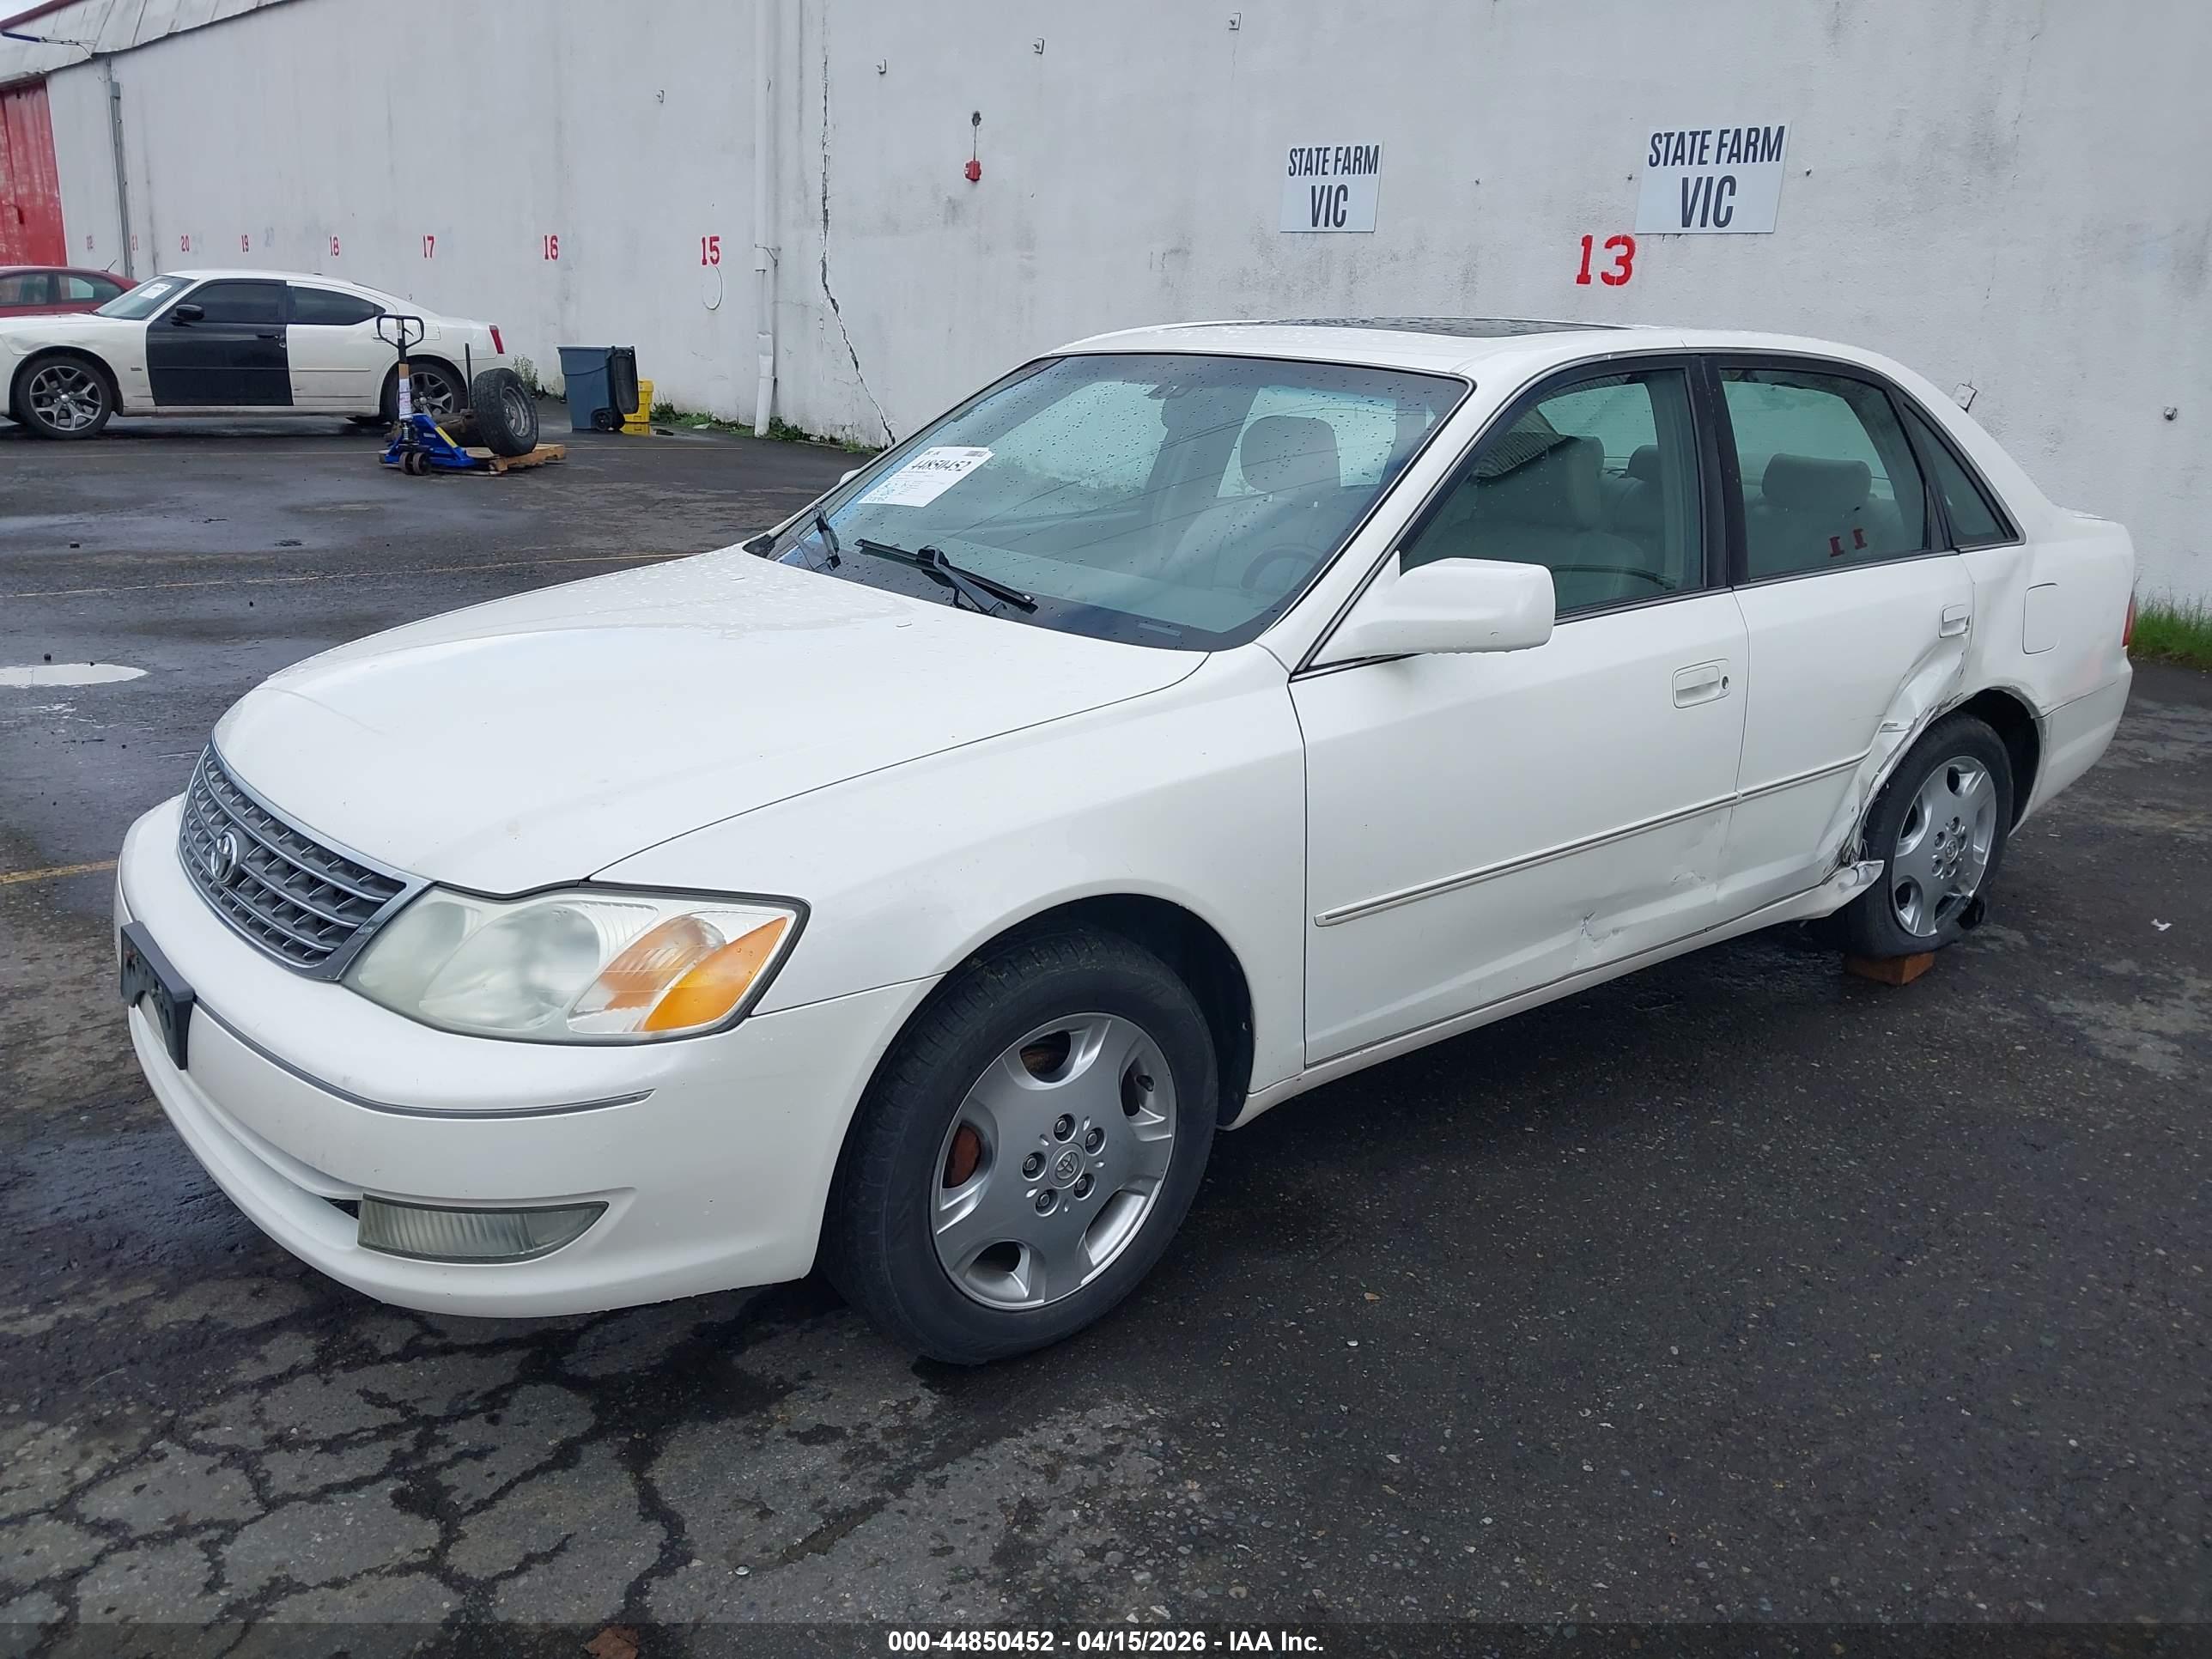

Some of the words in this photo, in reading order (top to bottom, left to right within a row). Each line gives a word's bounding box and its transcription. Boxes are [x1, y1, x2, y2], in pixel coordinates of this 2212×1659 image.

[1288, 147, 1331, 177] STATE
[1333, 144, 1380, 176] FARM
[1648, 130, 1712, 167] STATE
[1715, 125, 1785, 165] FARM
[1310, 184, 1349, 228] VIC
[1681, 175, 1737, 228] VIC
[179, 234, 191, 252] 20
[240, 234, 249, 252] 19
[329, 235, 340, 256] 18
[422, 234, 434, 258] 17
[544, 234, 558, 260] 16
[701, 235, 720, 265] 15
[1576, 234, 1636, 286] 13
